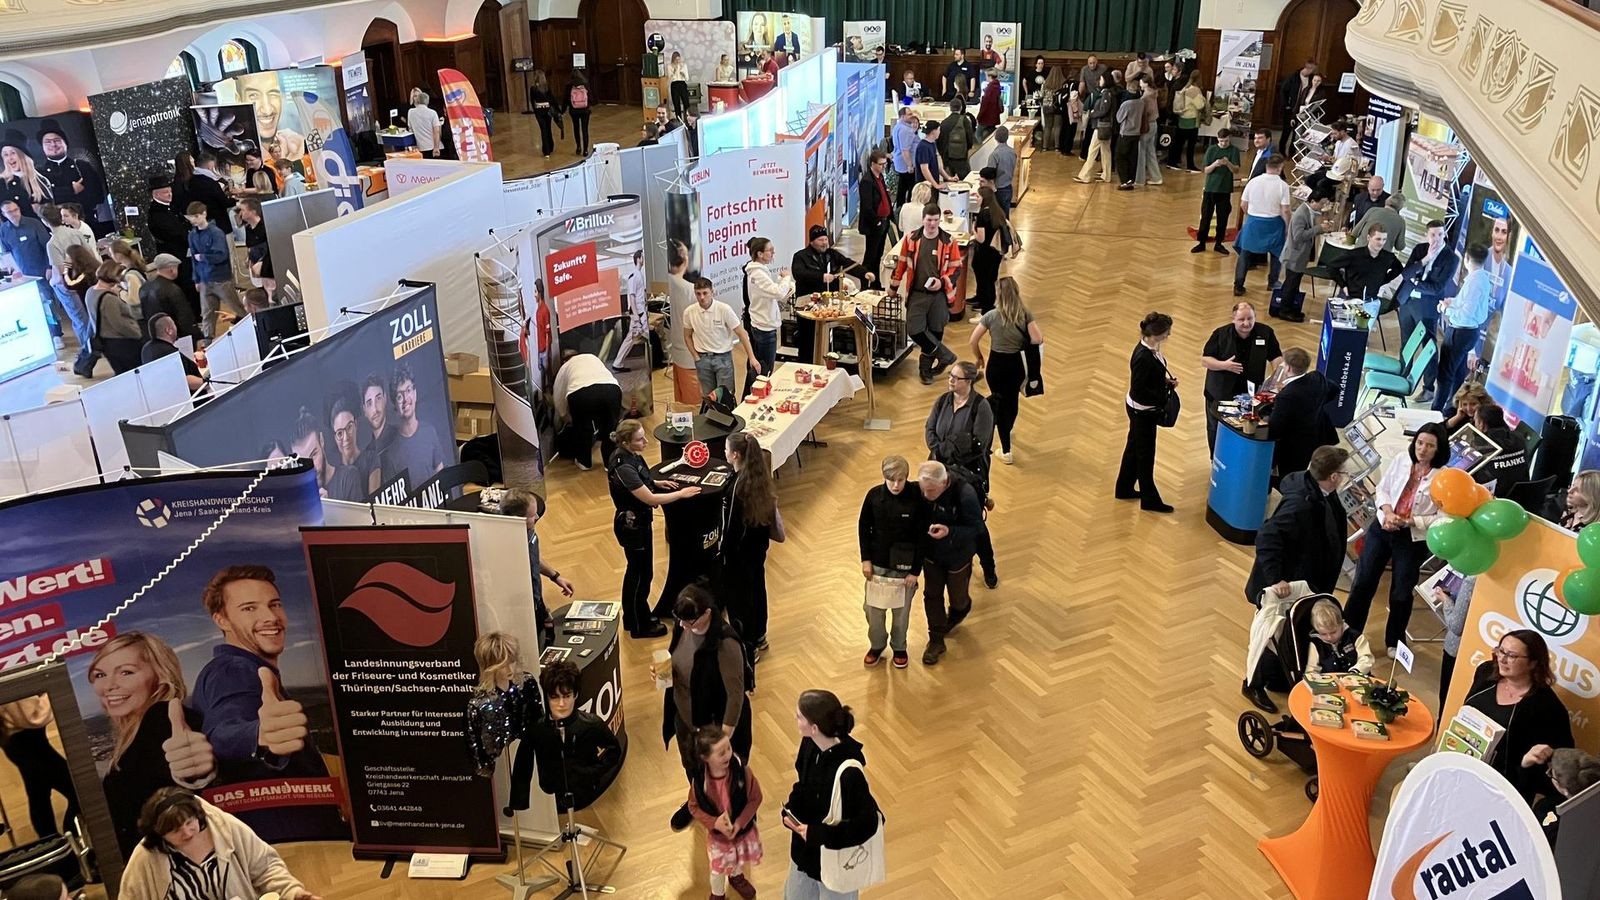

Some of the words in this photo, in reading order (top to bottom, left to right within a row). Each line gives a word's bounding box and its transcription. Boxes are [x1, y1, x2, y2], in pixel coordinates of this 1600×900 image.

[129, 105, 181, 132] jenaoptronik
[707, 193, 784, 223] Fortschritt
[576, 213, 615, 231] Brillux
[708, 217, 757, 244] beginnt
[553, 254, 587, 273] Zukunft?
[709, 245, 727, 265] mit
[554, 272, 572, 285] Safe.
[389, 304, 432, 345] ZOLL
[401, 332, 427, 354] KARRIERE
[1338, 351, 1352, 408] www.debeka.de
[1494, 456, 1525, 469] FRANKE
[173, 509, 193, 518] Jena
[0, 558, 105, 606] Wert!
[0, 613, 55, 640] en.
[344, 659, 461, 669] Landesinnungsverband
[332, 672, 349, 680] der
[351, 672, 395, 680] Friseure-
[398, 672, 418, 680] und
[420, 672, 477, 681] Kosmetiker
[340, 684, 474, 694] Thüringen/Sachsen-Anhalt
[352, 729, 400, 737] Entwicklung
[380, 720, 425, 728] Ausbildung
[365, 773, 440, 781] Kreishandwerkerschaft
[213, 789, 245, 803] DAS
[249, 782, 333, 797] HANDWERK
[1420, 819, 1517, 900] rautal
